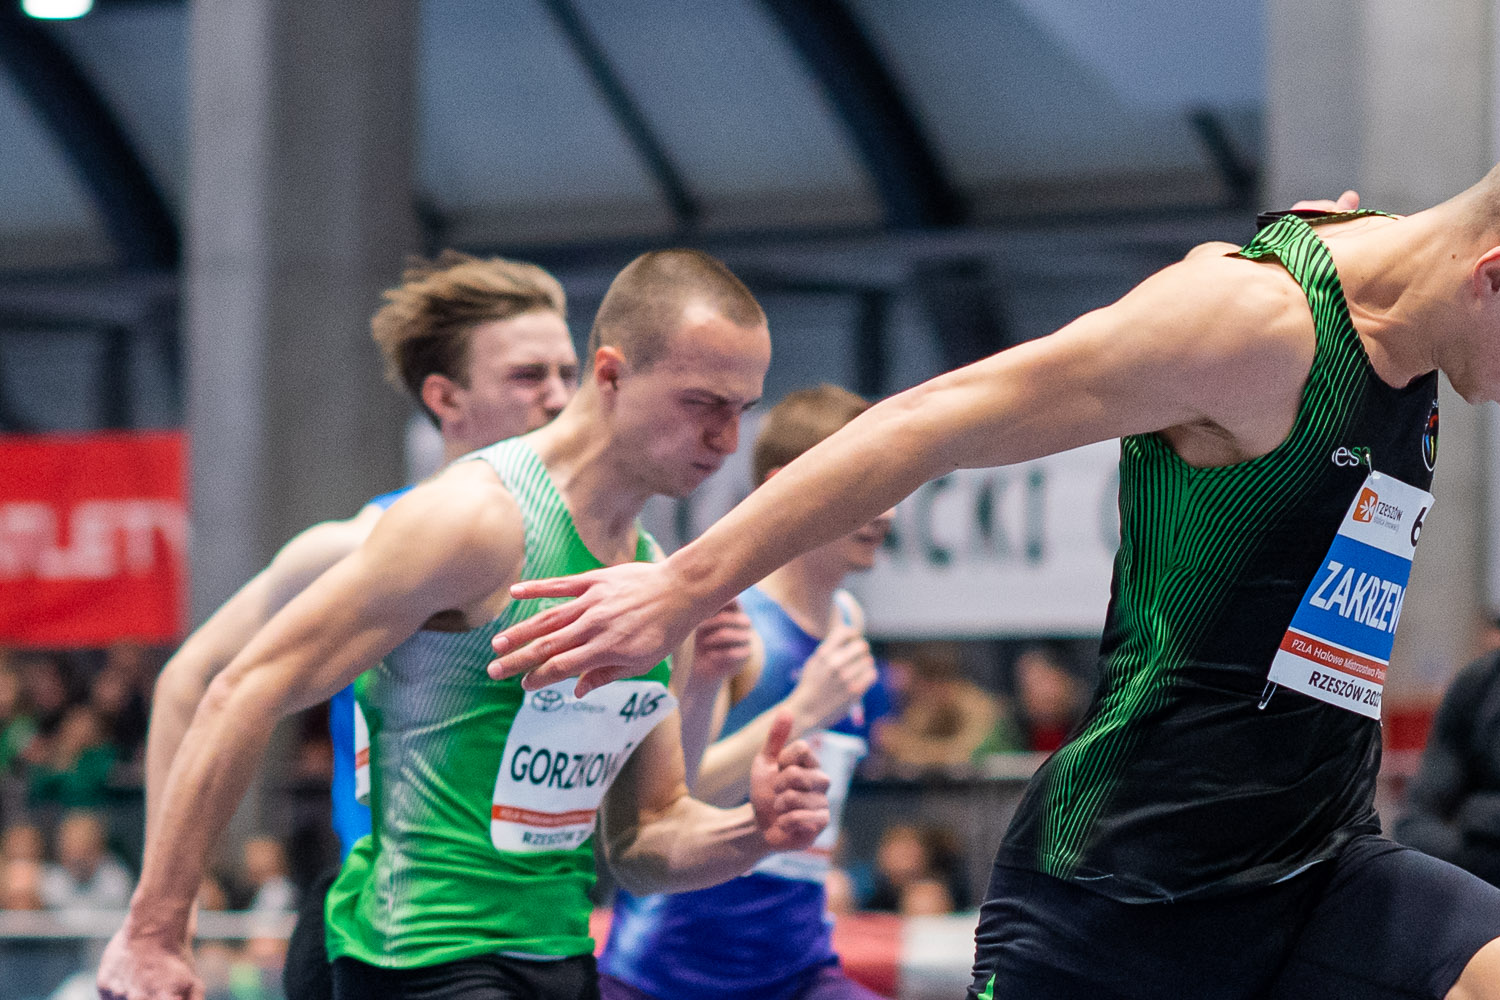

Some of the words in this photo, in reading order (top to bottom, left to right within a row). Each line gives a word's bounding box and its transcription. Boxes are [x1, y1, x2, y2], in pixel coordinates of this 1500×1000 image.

[1291, 639, 1312, 655] PZLA
[1314, 646, 1344, 666] Halowe
[1308, 670, 1364, 702] RZESZÓW
